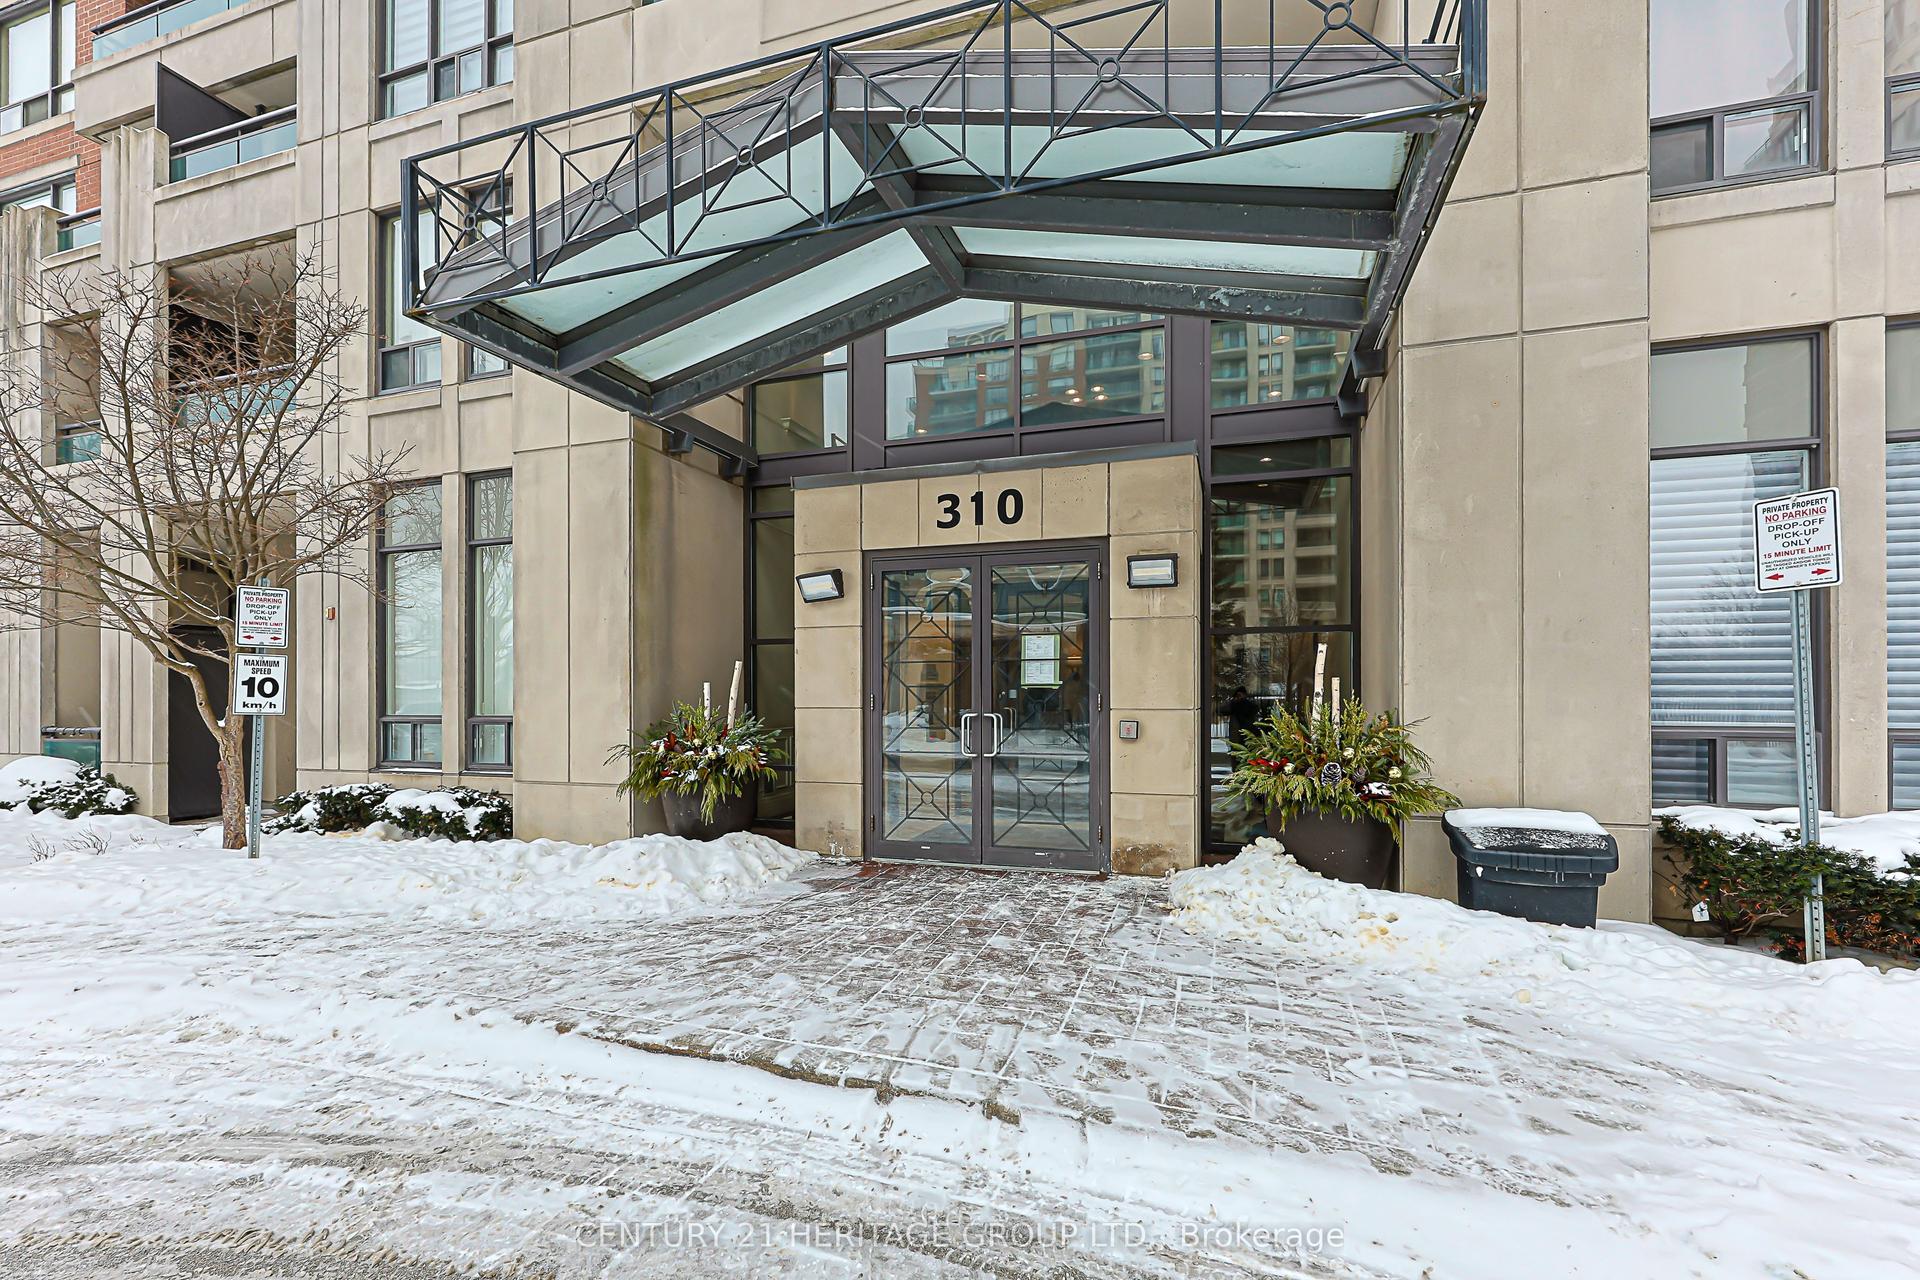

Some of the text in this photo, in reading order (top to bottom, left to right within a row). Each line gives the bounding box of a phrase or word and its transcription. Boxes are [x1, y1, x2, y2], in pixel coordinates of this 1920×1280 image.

[937, 488, 1023, 529] 310
[1762, 497, 1829, 514] PRIVATE PROPERTY
[1765, 506, 1827, 523] NO PARKING
[1767, 517, 1825, 533] DROP-OFF
[1774, 527, 1819, 540] PICK-UP
[1781, 538, 1811, 548] ONLY
[1774, 548, 1806, 558] MINUTE
[1808, 544, 1832, 553] LIMIT
[243, 659, 280, 668] MAXIMUM
[251, 667, 272, 675] SPEED
[241, 676, 279, 698] 10
[242, 701, 277, 709] km/h
